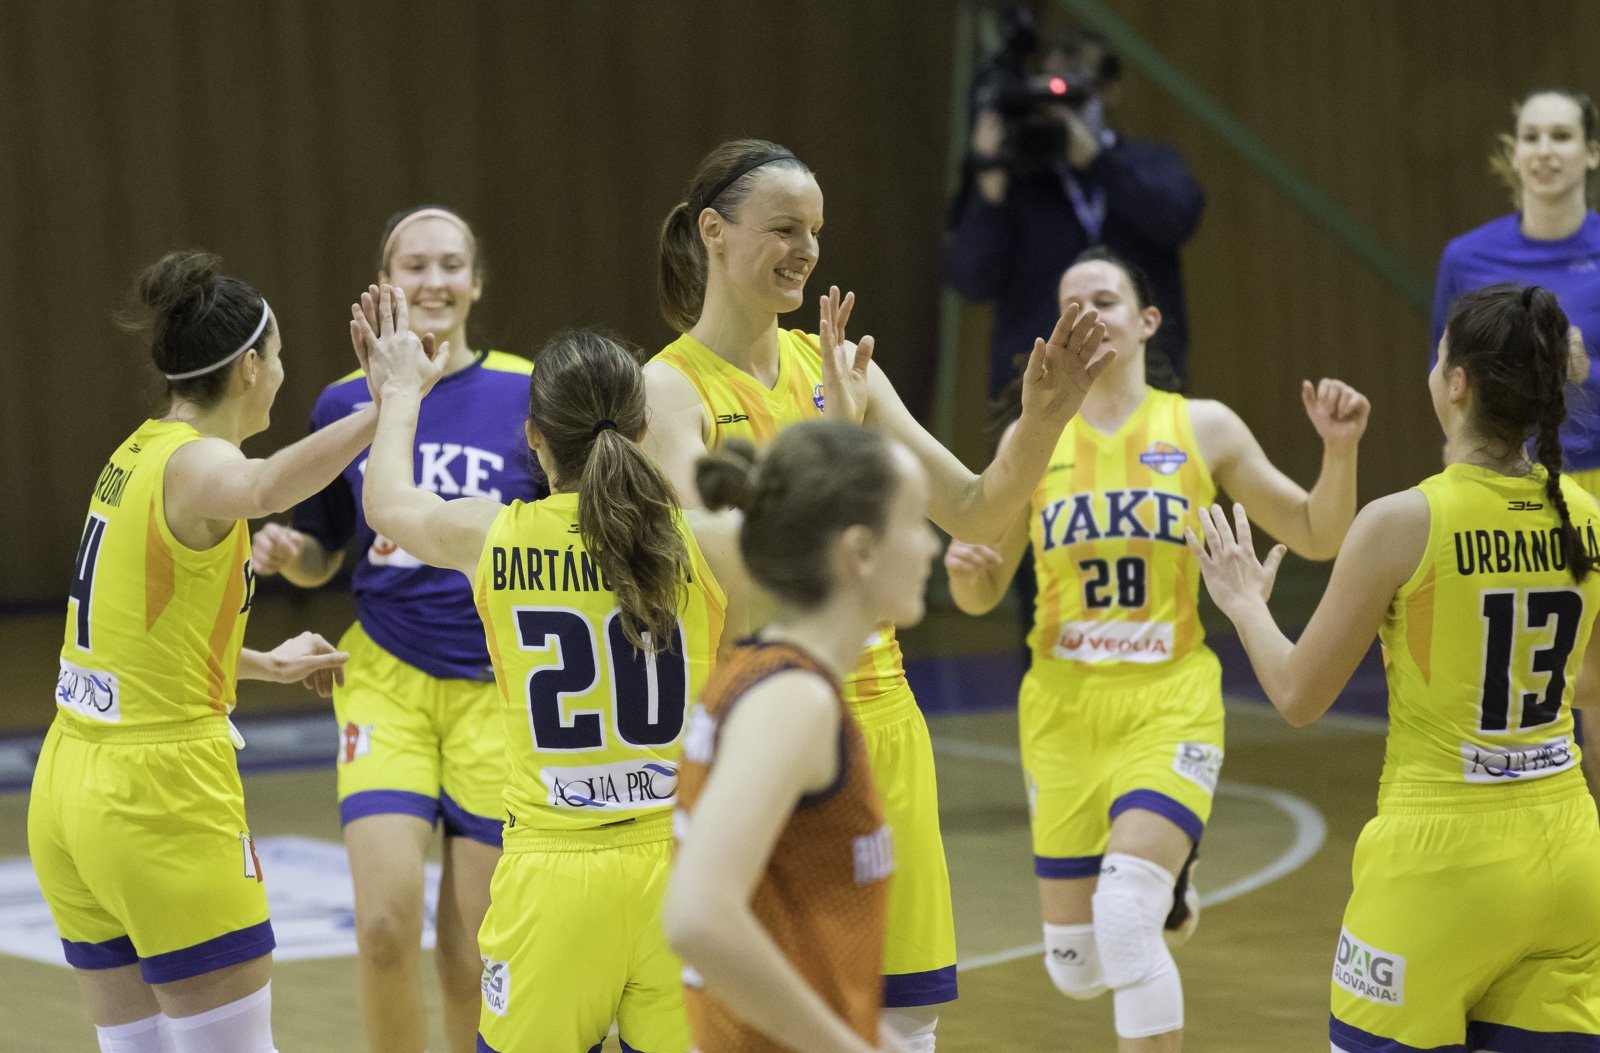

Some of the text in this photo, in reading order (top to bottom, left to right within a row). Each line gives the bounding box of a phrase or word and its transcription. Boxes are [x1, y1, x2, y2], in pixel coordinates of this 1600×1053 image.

[1041, 489, 1189, 551] YAKE
[1454, 518, 1600, 576] URBANOÁ
[1079, 557, 1147, 609] 28
[1089, 637, 1167, 654] VEOLIA
[1477, 587, 1585, 735] 13
[512, 606, 689, 752] 20
[553, 763, 679, 807] AQUA PRO
[1334, 963, 1392, 1002] SLOVAKIA
[1338, 933, 1394, 987] DAG
